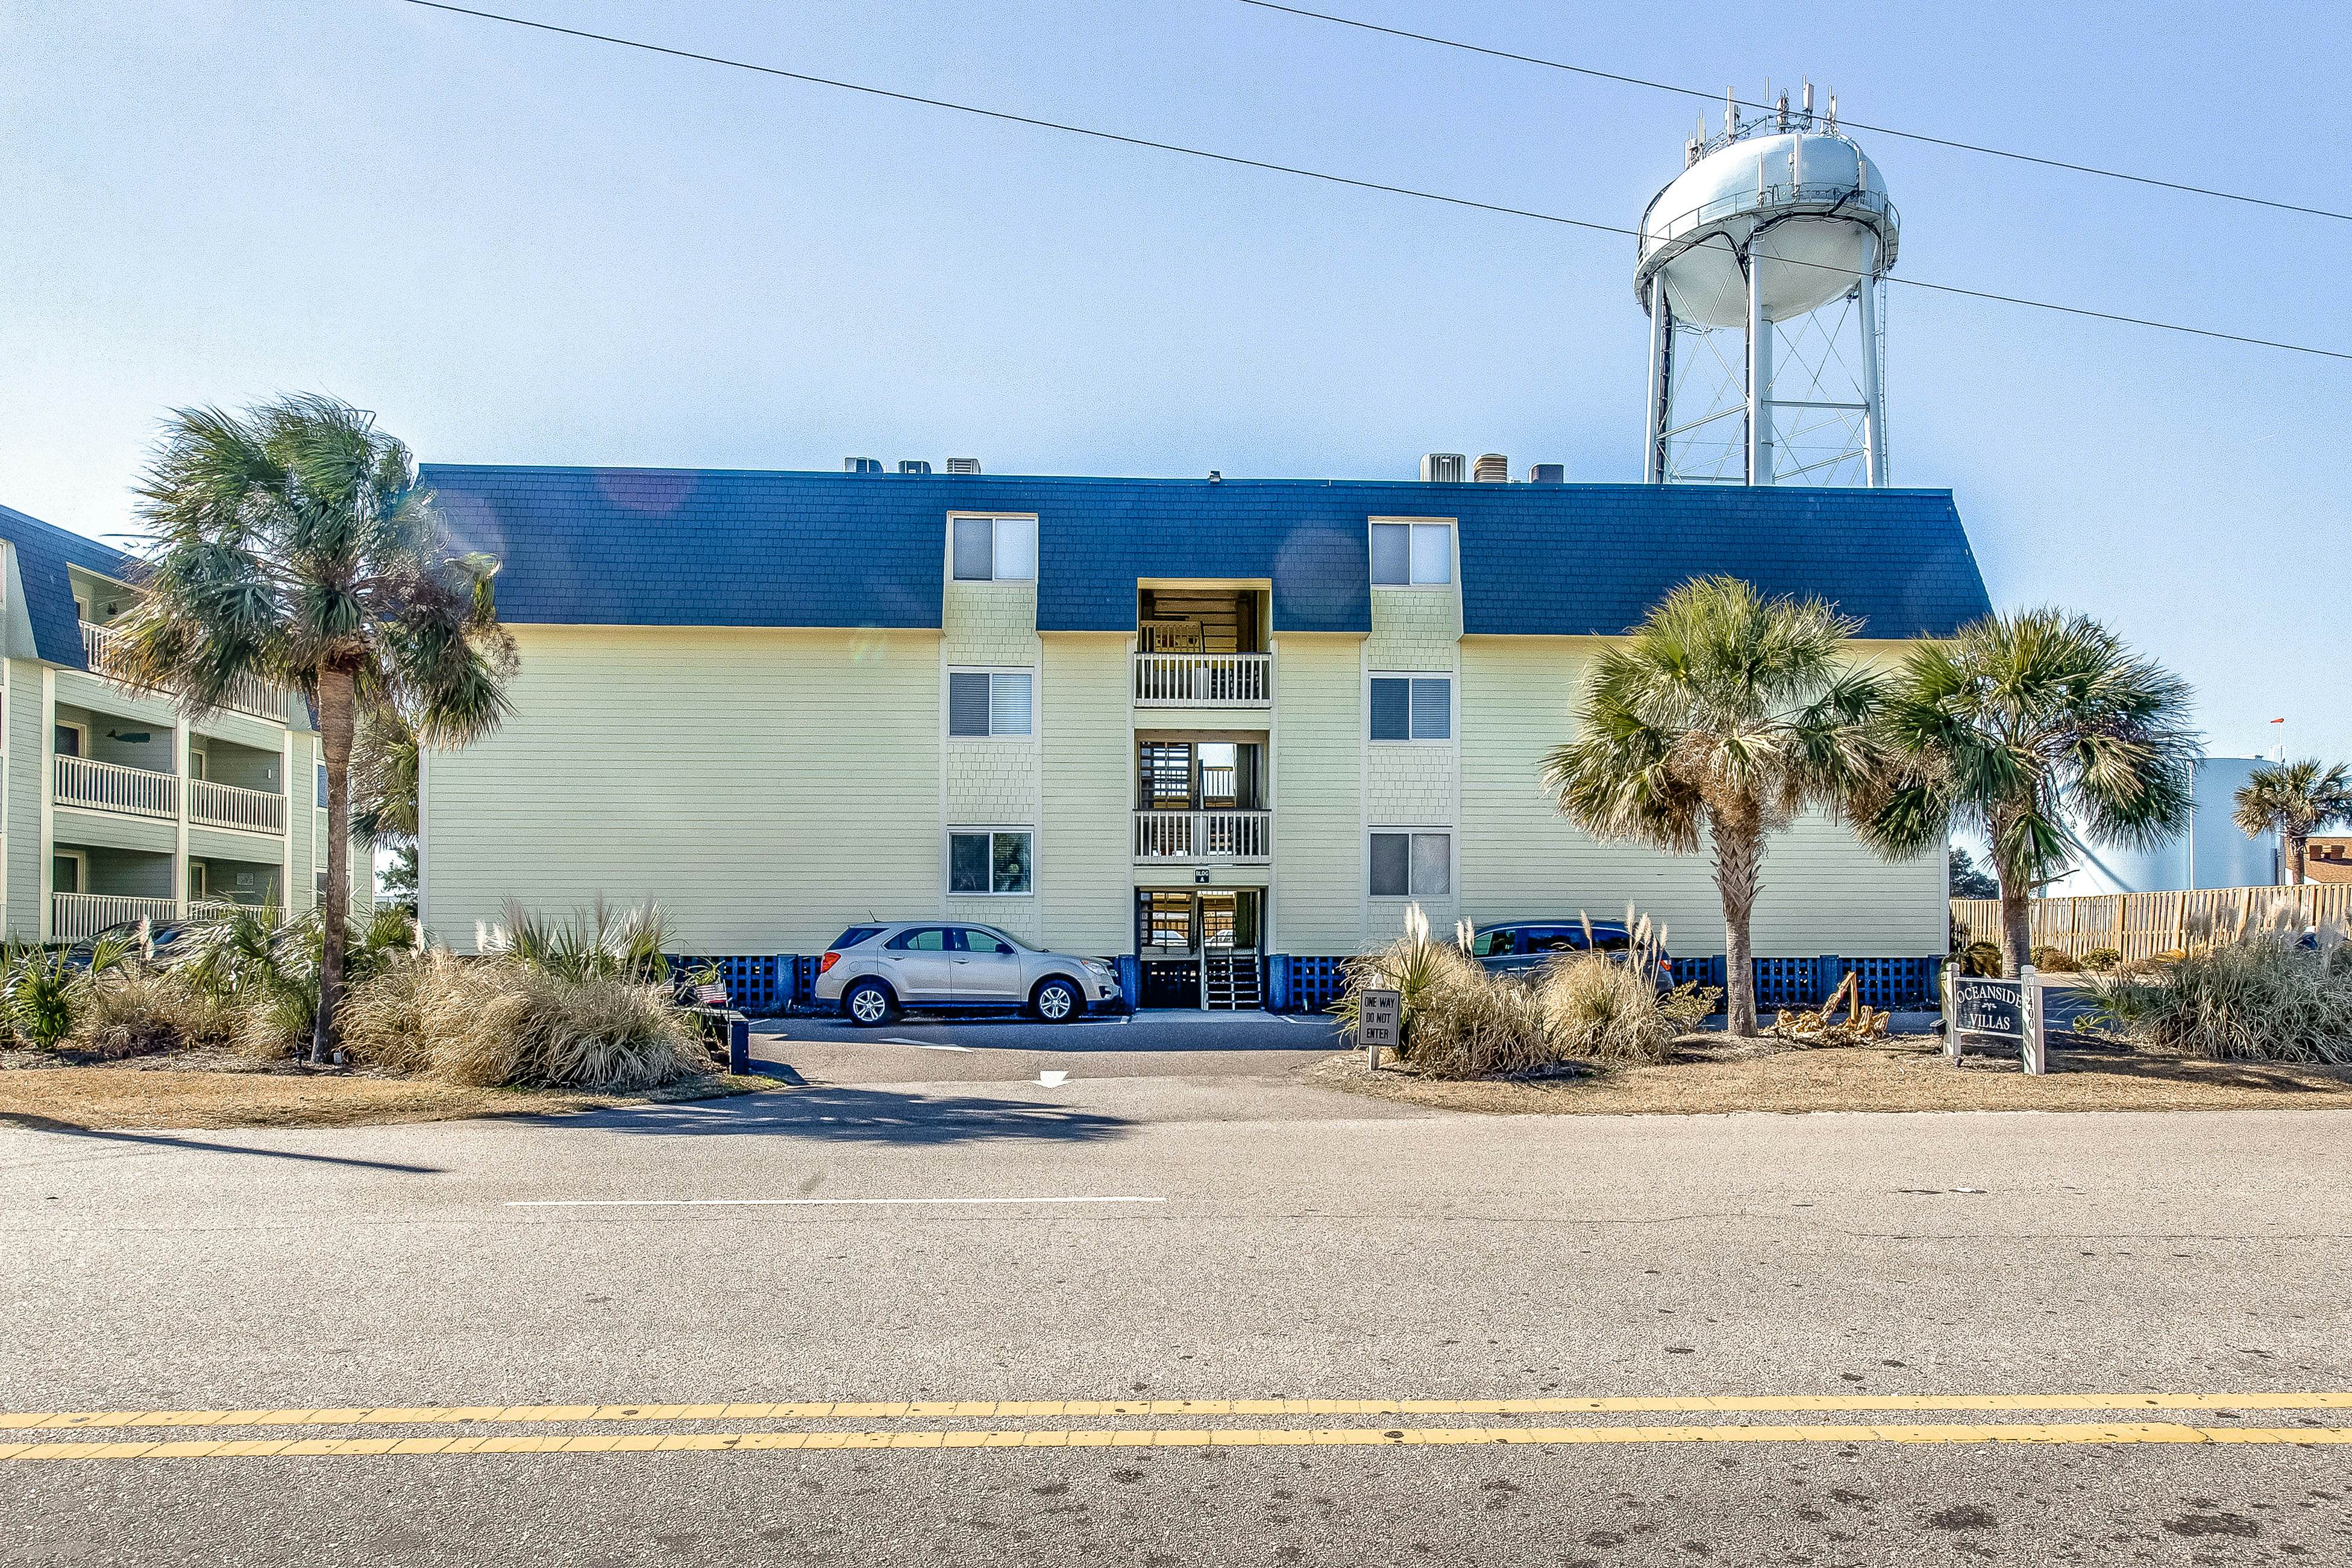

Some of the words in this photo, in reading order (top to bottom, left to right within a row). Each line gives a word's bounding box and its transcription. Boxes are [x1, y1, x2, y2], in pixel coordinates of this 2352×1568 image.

[1364, 996, 1377, 1008] ONE
[1379, 997, 1396, 1008] WAY
[1957, 985, 2022, 1009] OCEANSIDE
[1366, 1012, 1374, 1023] DO
[1376, 1013, 1391, 1024] NOT
[1969, 1013, 2010, 1030] VILLAS
[1366, 1028, 1389, 1040] ENTER
